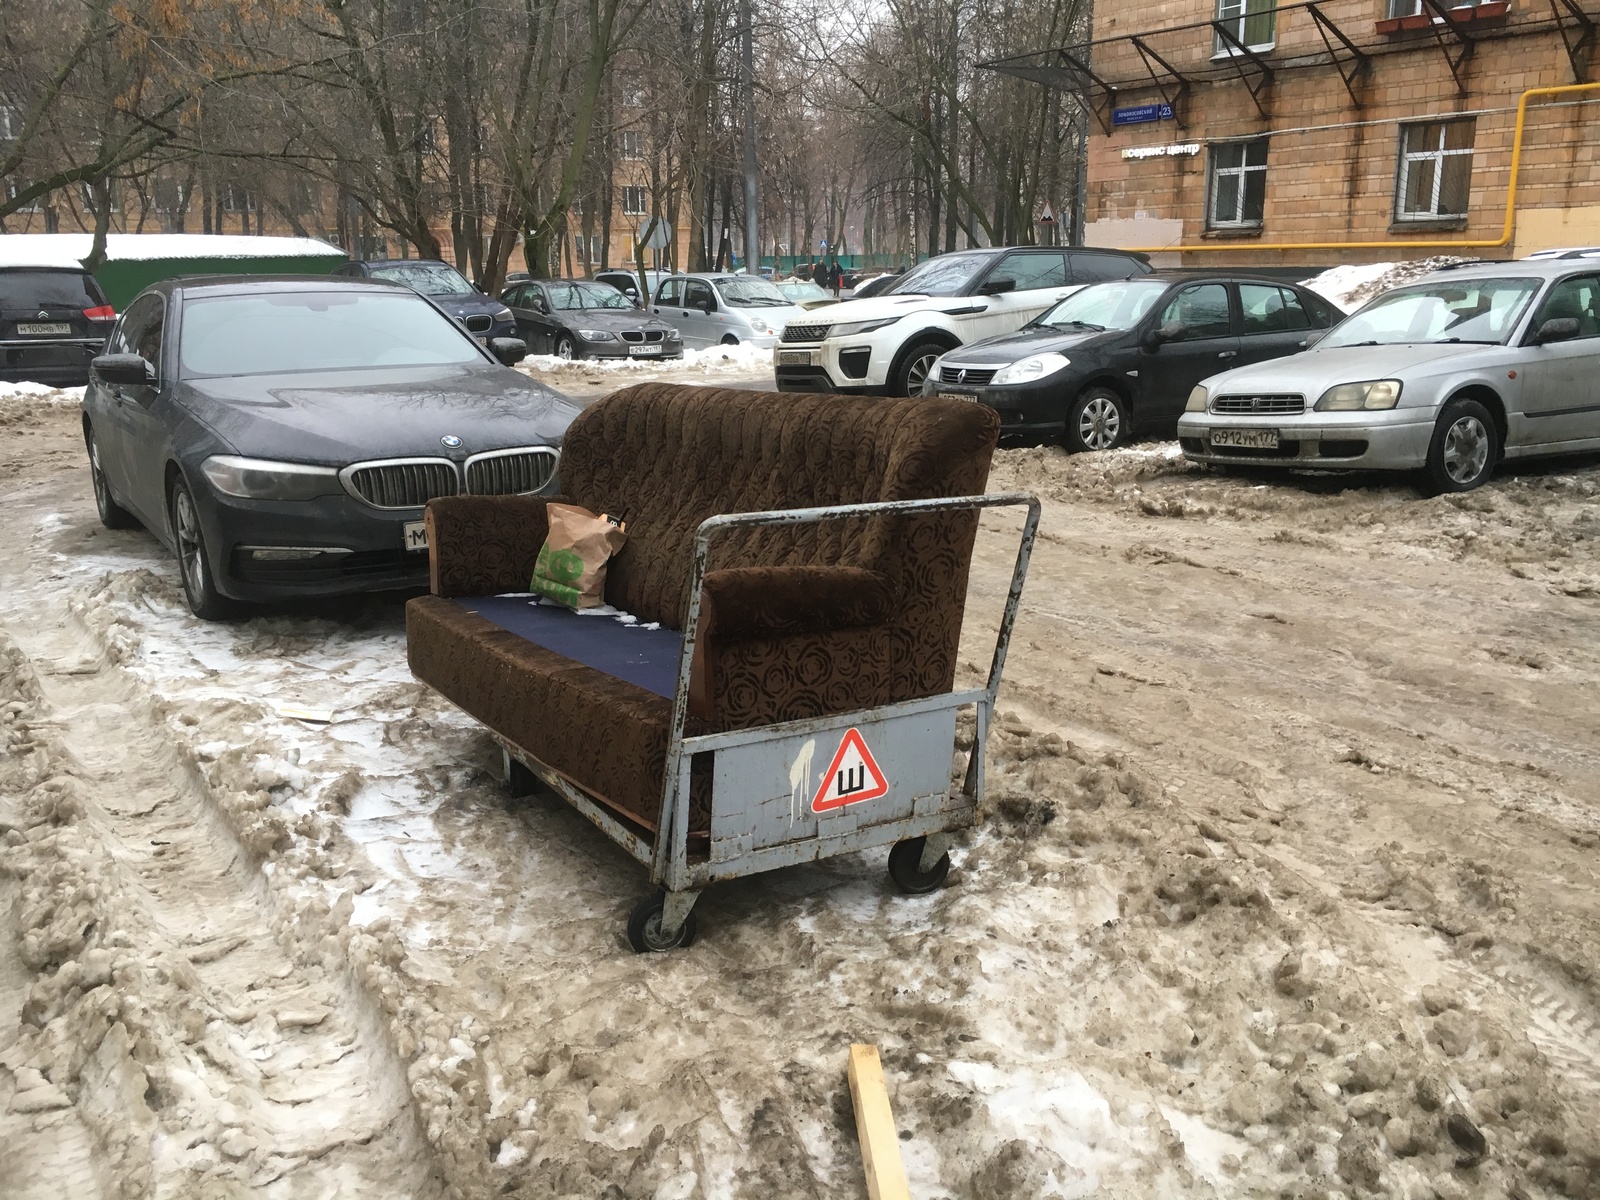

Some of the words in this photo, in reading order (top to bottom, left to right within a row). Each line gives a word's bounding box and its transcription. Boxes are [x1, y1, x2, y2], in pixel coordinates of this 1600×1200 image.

[1118, 108, 1152, 118] ЛОМОНОСОВСКИЙ
[1162, 106, 1171, 116] 23
[1166, 143, 1200, 156] центр
[1213, 431, 1256, 446] О912УМ
[1258, 432, 1275, 443] 177
[838, 765, 864, 795] Ш
